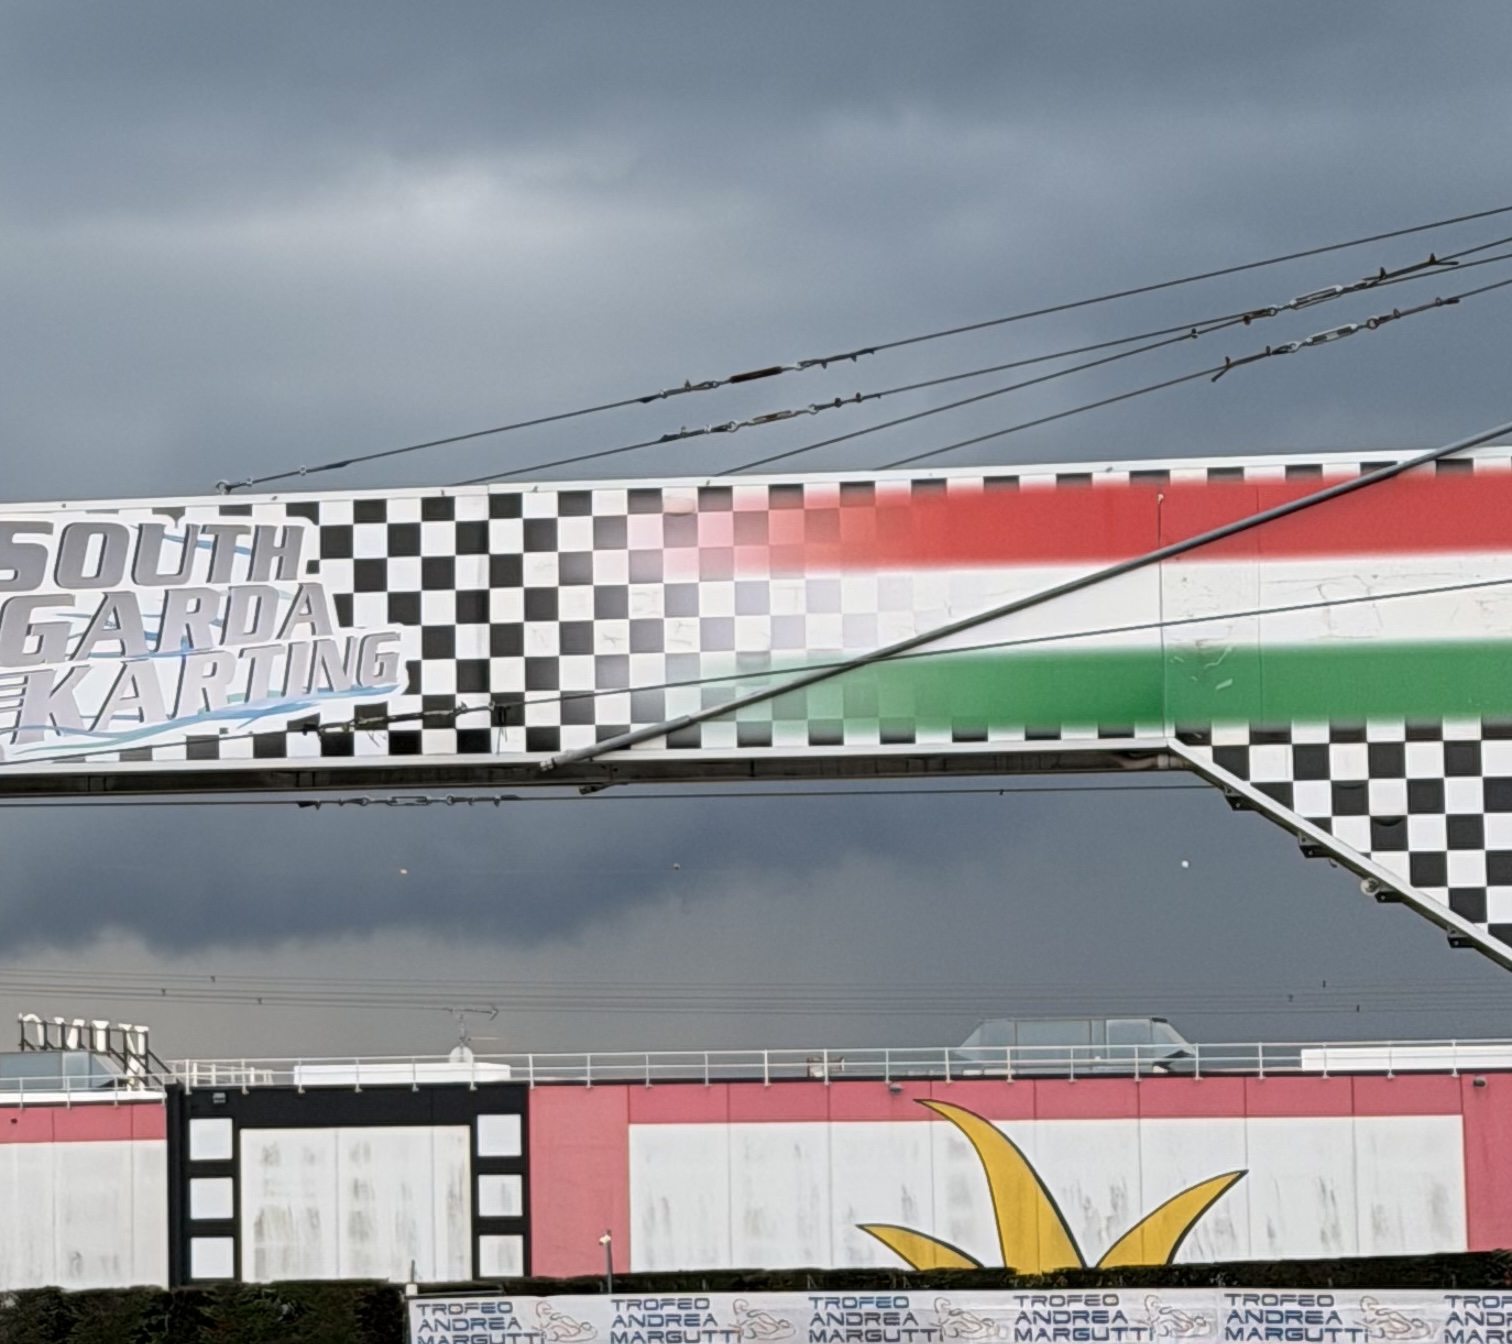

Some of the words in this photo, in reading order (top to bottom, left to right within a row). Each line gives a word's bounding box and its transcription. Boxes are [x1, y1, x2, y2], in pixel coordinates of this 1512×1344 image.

[11, 631, 402, 746] KARTING
[610, 1297, 710, 1312] TROFEO
[808, 1296, 909, 1310] TROFEO
[1013, 1294, 1120, 1307] TROFEO
[1224, 1293, 1335, 1307] TROFEO
[416, 1301, 513, 1316] TROFEO
[611, 1313, 718, 1328] ANDREA
[810, 1311, 919, 1326] ANDREA
[1015, 1310, 1128, 1325] ANDREA
[1226, 1309, 1343, 1325] ANDREA
[418, 1317, 522, 1333] ANDREA
